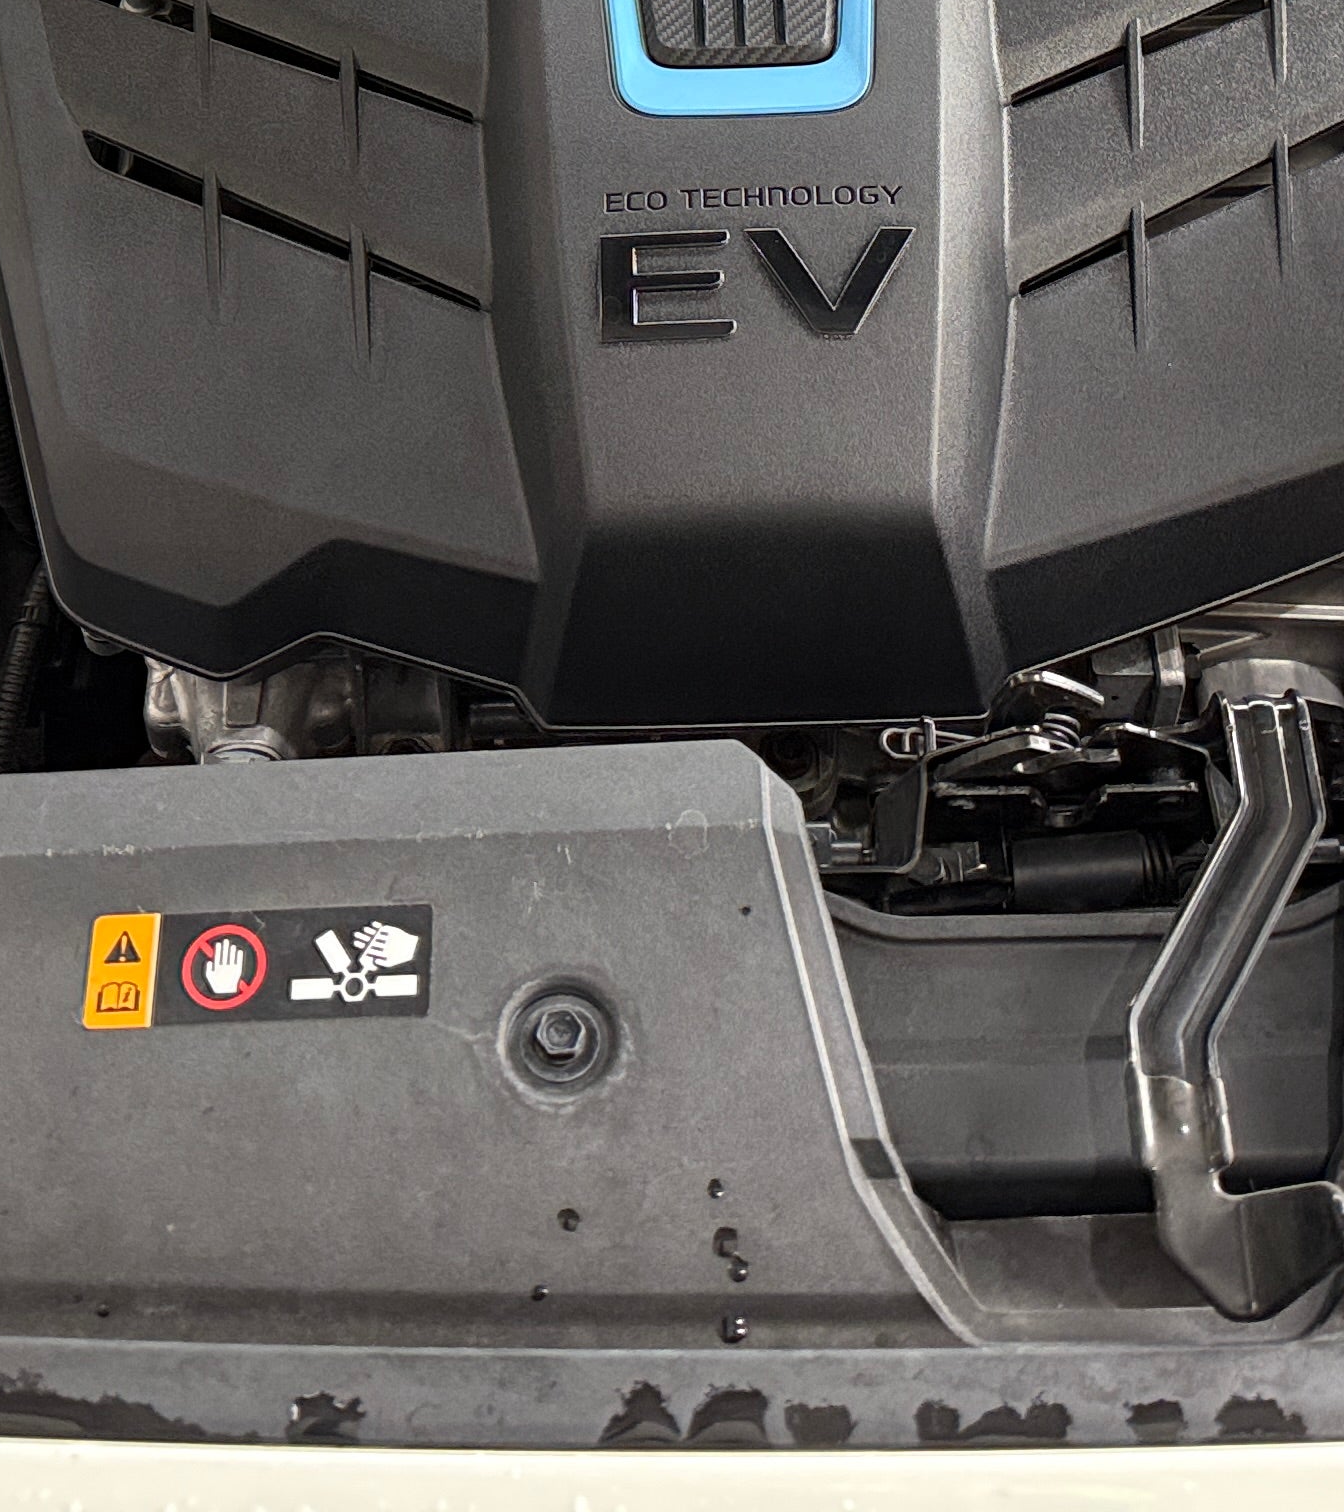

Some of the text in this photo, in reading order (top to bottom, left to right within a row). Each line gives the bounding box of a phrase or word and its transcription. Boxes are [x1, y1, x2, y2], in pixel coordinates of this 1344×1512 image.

[603, 185, 903, 214] ECO TECHNOLOGY
[599, 226, 916, 343] EV
